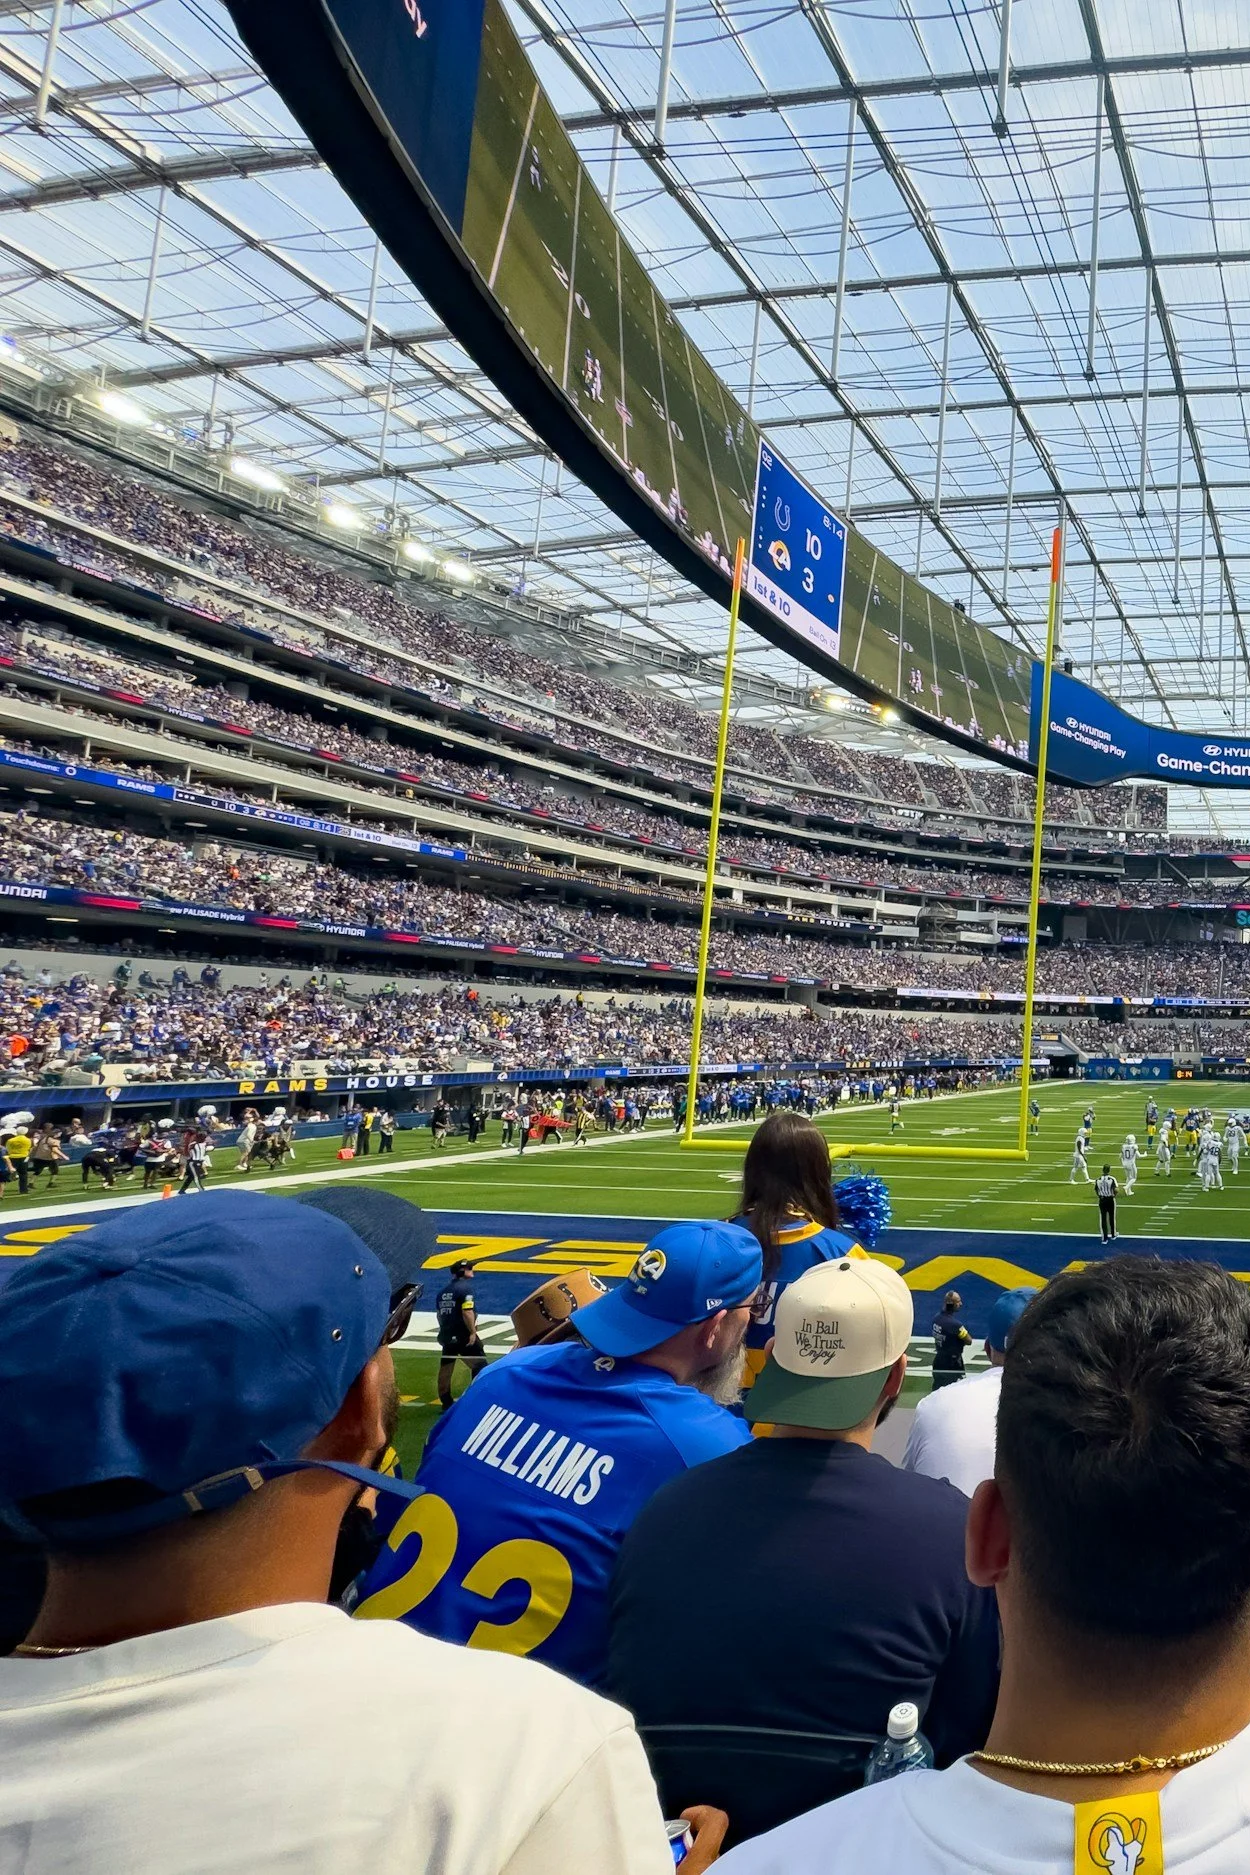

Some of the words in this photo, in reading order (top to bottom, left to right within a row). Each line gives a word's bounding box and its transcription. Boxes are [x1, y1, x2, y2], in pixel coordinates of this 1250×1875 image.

[822, 514, 843, 541] 8:14
[806, 527, 822, 561] 10
[802, 567, 814, 593] 3
[754, 576, 768, 599] 1st
[770, 591, 776, 605] &
[779, 597, 791, 617] 10
[168, 707, 205, 723] HYUNDAI
[1050, 721, 1109, 754] Game-Changing
[1109, 744, 1126, 759] Play
[1078, 722, 1111, 742] HYUNDAI
[65, 766, 77, 777] 0
[117, 778, 156, 794] RAMS
[225, 803, 236, 812] 10
[243, 806, 250, 814] 3
[183, 908, 219, 920] PALISADE
[220, 912, 245, 923] Hybrid
[325, 925, 366, 938] HYUNDAI
[238, 1078, 328, 1094] RAMS
[347, 1074, 434, 1090] HOUSE
[801, 1318, 811, 1334] In
[812, 1319, 839, 1335] Ball
[794, 1331, 811, 1349] We
[813, 1333, 846, 1350] Trust.
[799, 1345, 836, 1364] Enjoy
[461, 1403, 615, 1506] WILLIAMS
